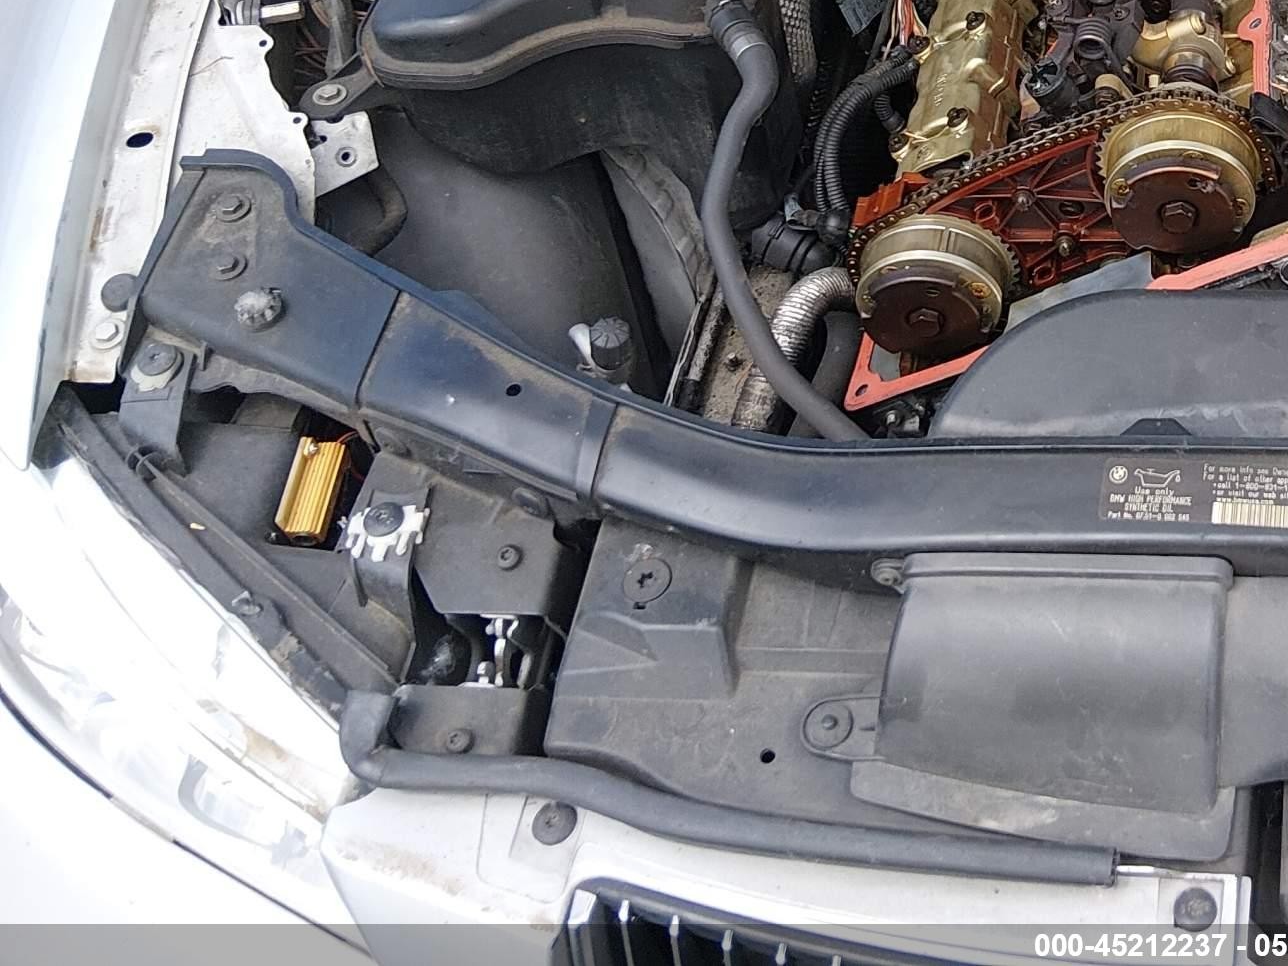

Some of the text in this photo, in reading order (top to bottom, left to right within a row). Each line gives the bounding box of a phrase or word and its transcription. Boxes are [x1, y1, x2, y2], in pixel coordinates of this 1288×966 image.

[1203, 463, 1215, 472] For
[1203, 471, 1214, 481] For
[1134, 486, 1174, 496] Use only
[1110, 494, 1193, 506] BMW HIGH PERFORMANCE
[1125, 503, 1174, 512] SYNTHETIC OIL
